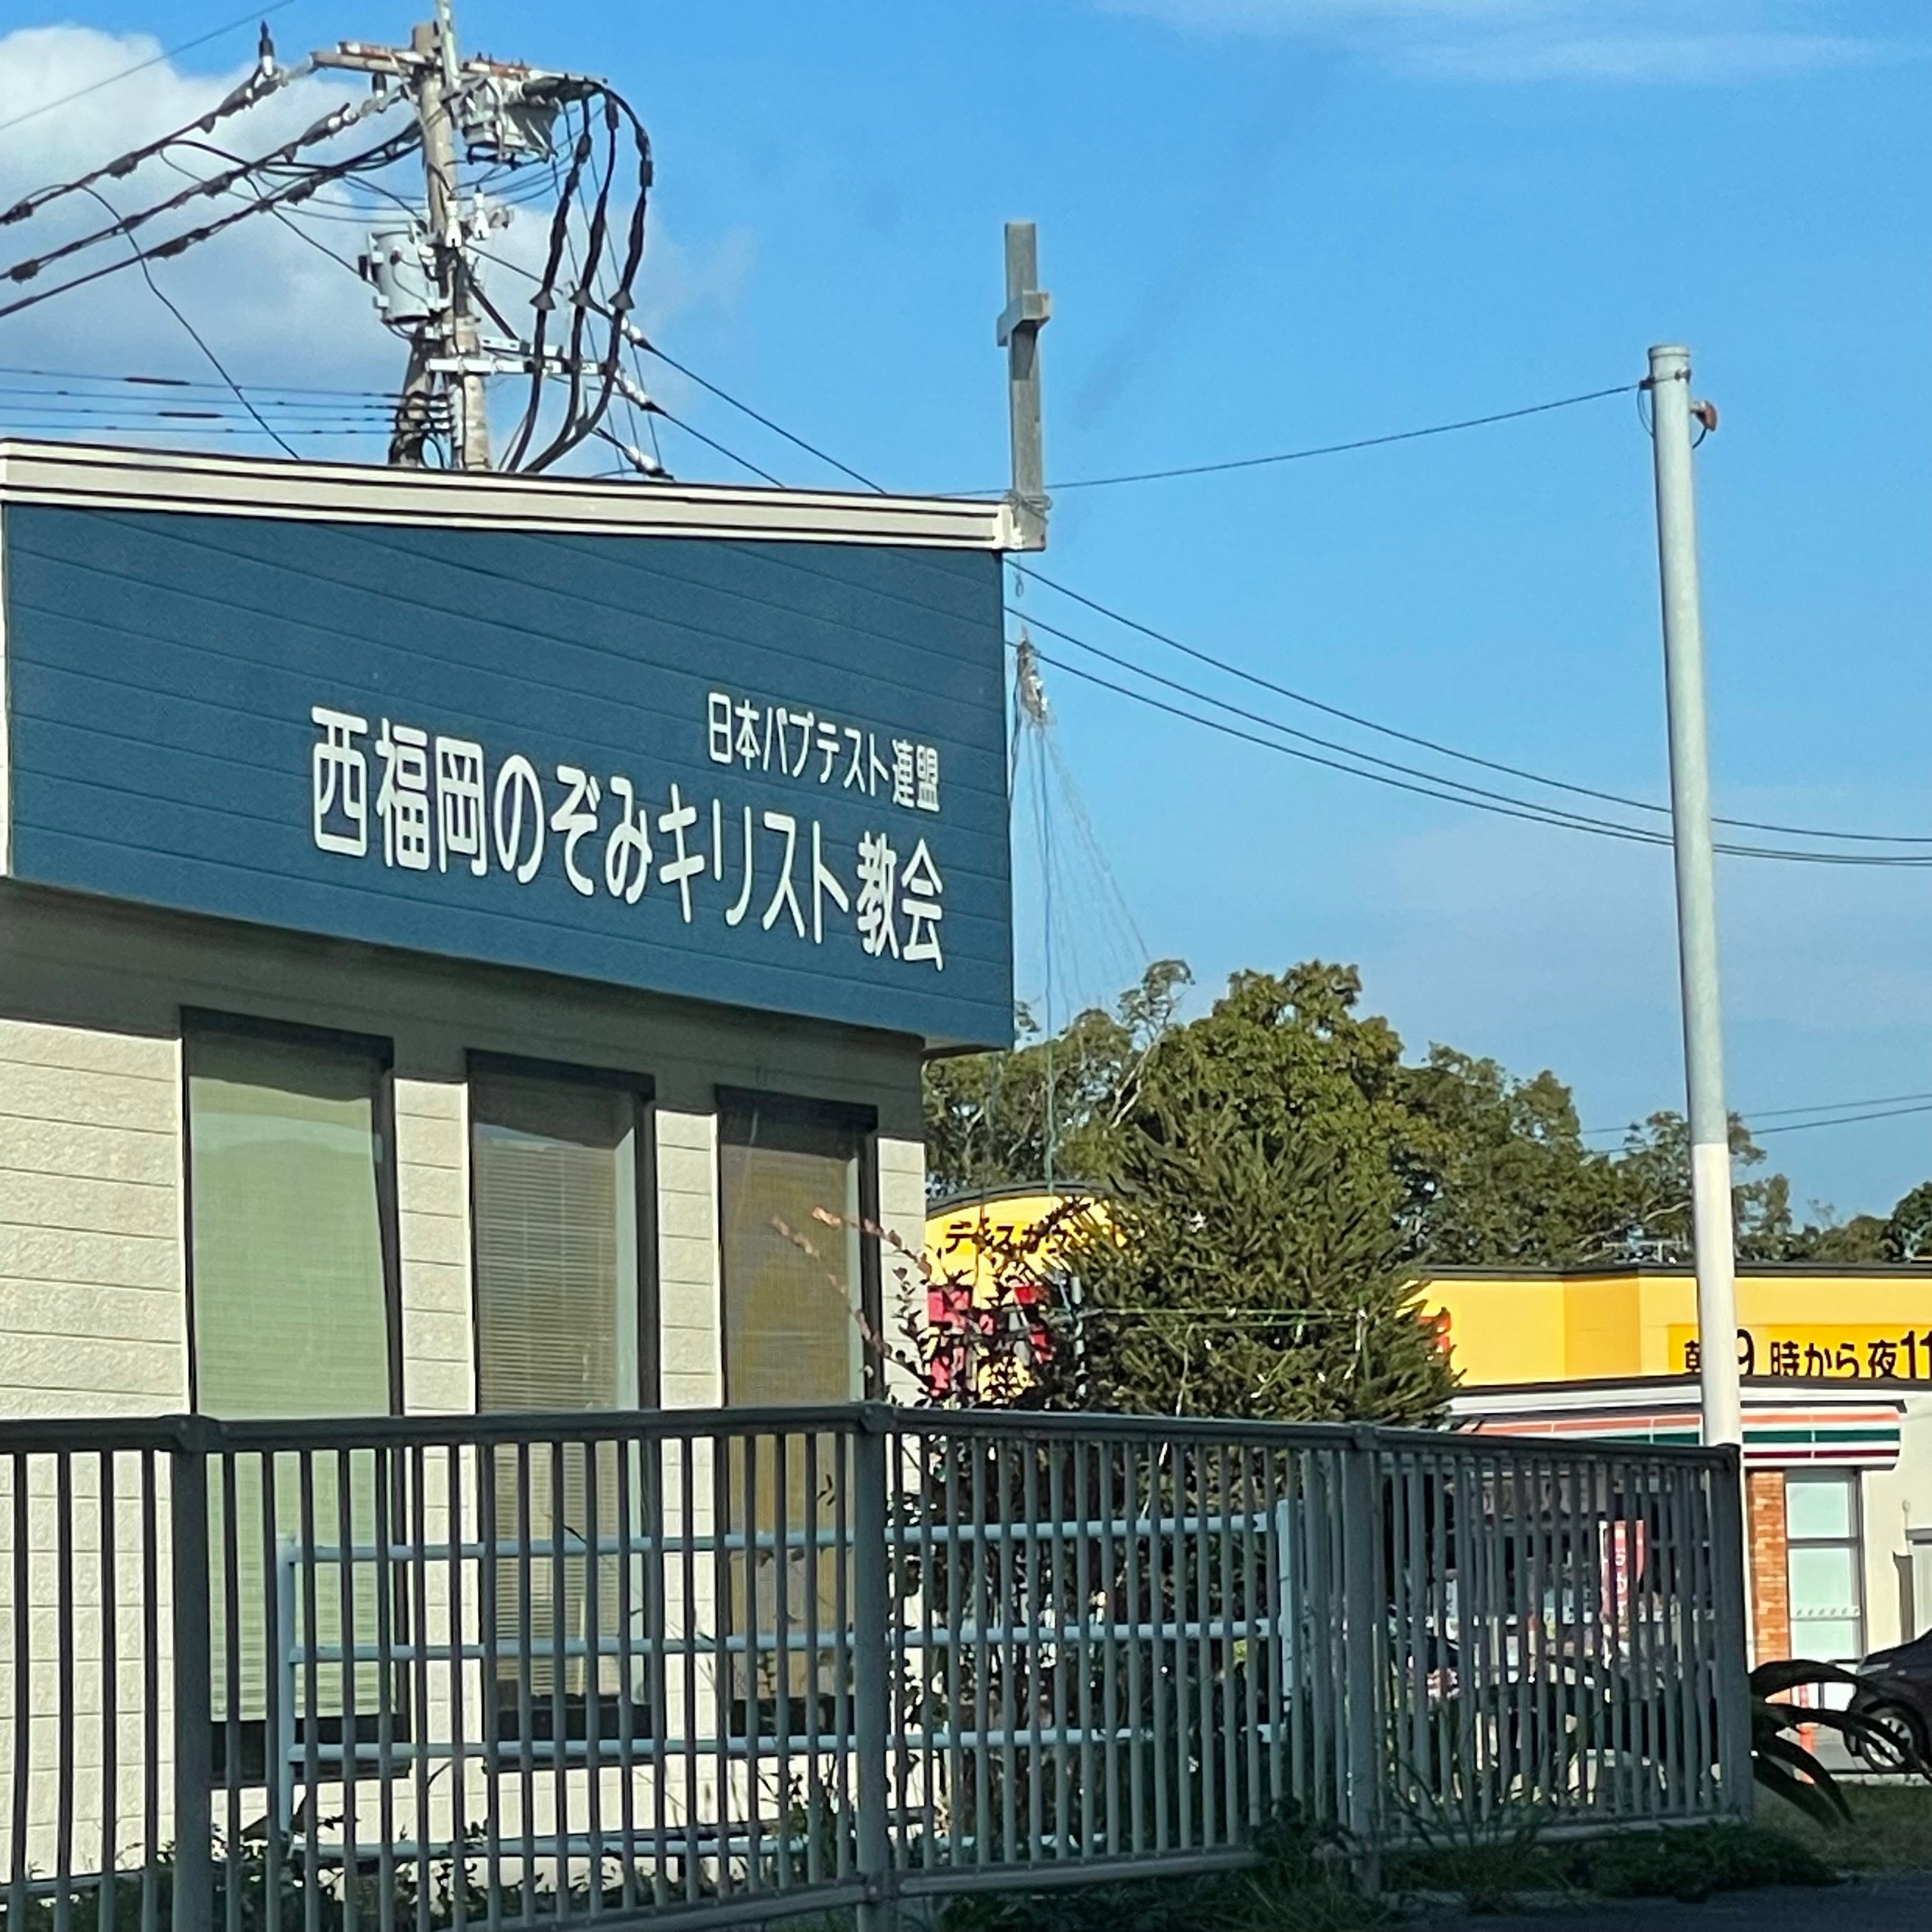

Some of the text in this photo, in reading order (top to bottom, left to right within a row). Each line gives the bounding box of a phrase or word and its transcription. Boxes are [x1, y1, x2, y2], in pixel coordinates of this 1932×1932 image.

[312, 706, 944, 970] 西福岡のぞみキリスト教会
[708, 693, 940, 812] 日本バプテスト連盟
